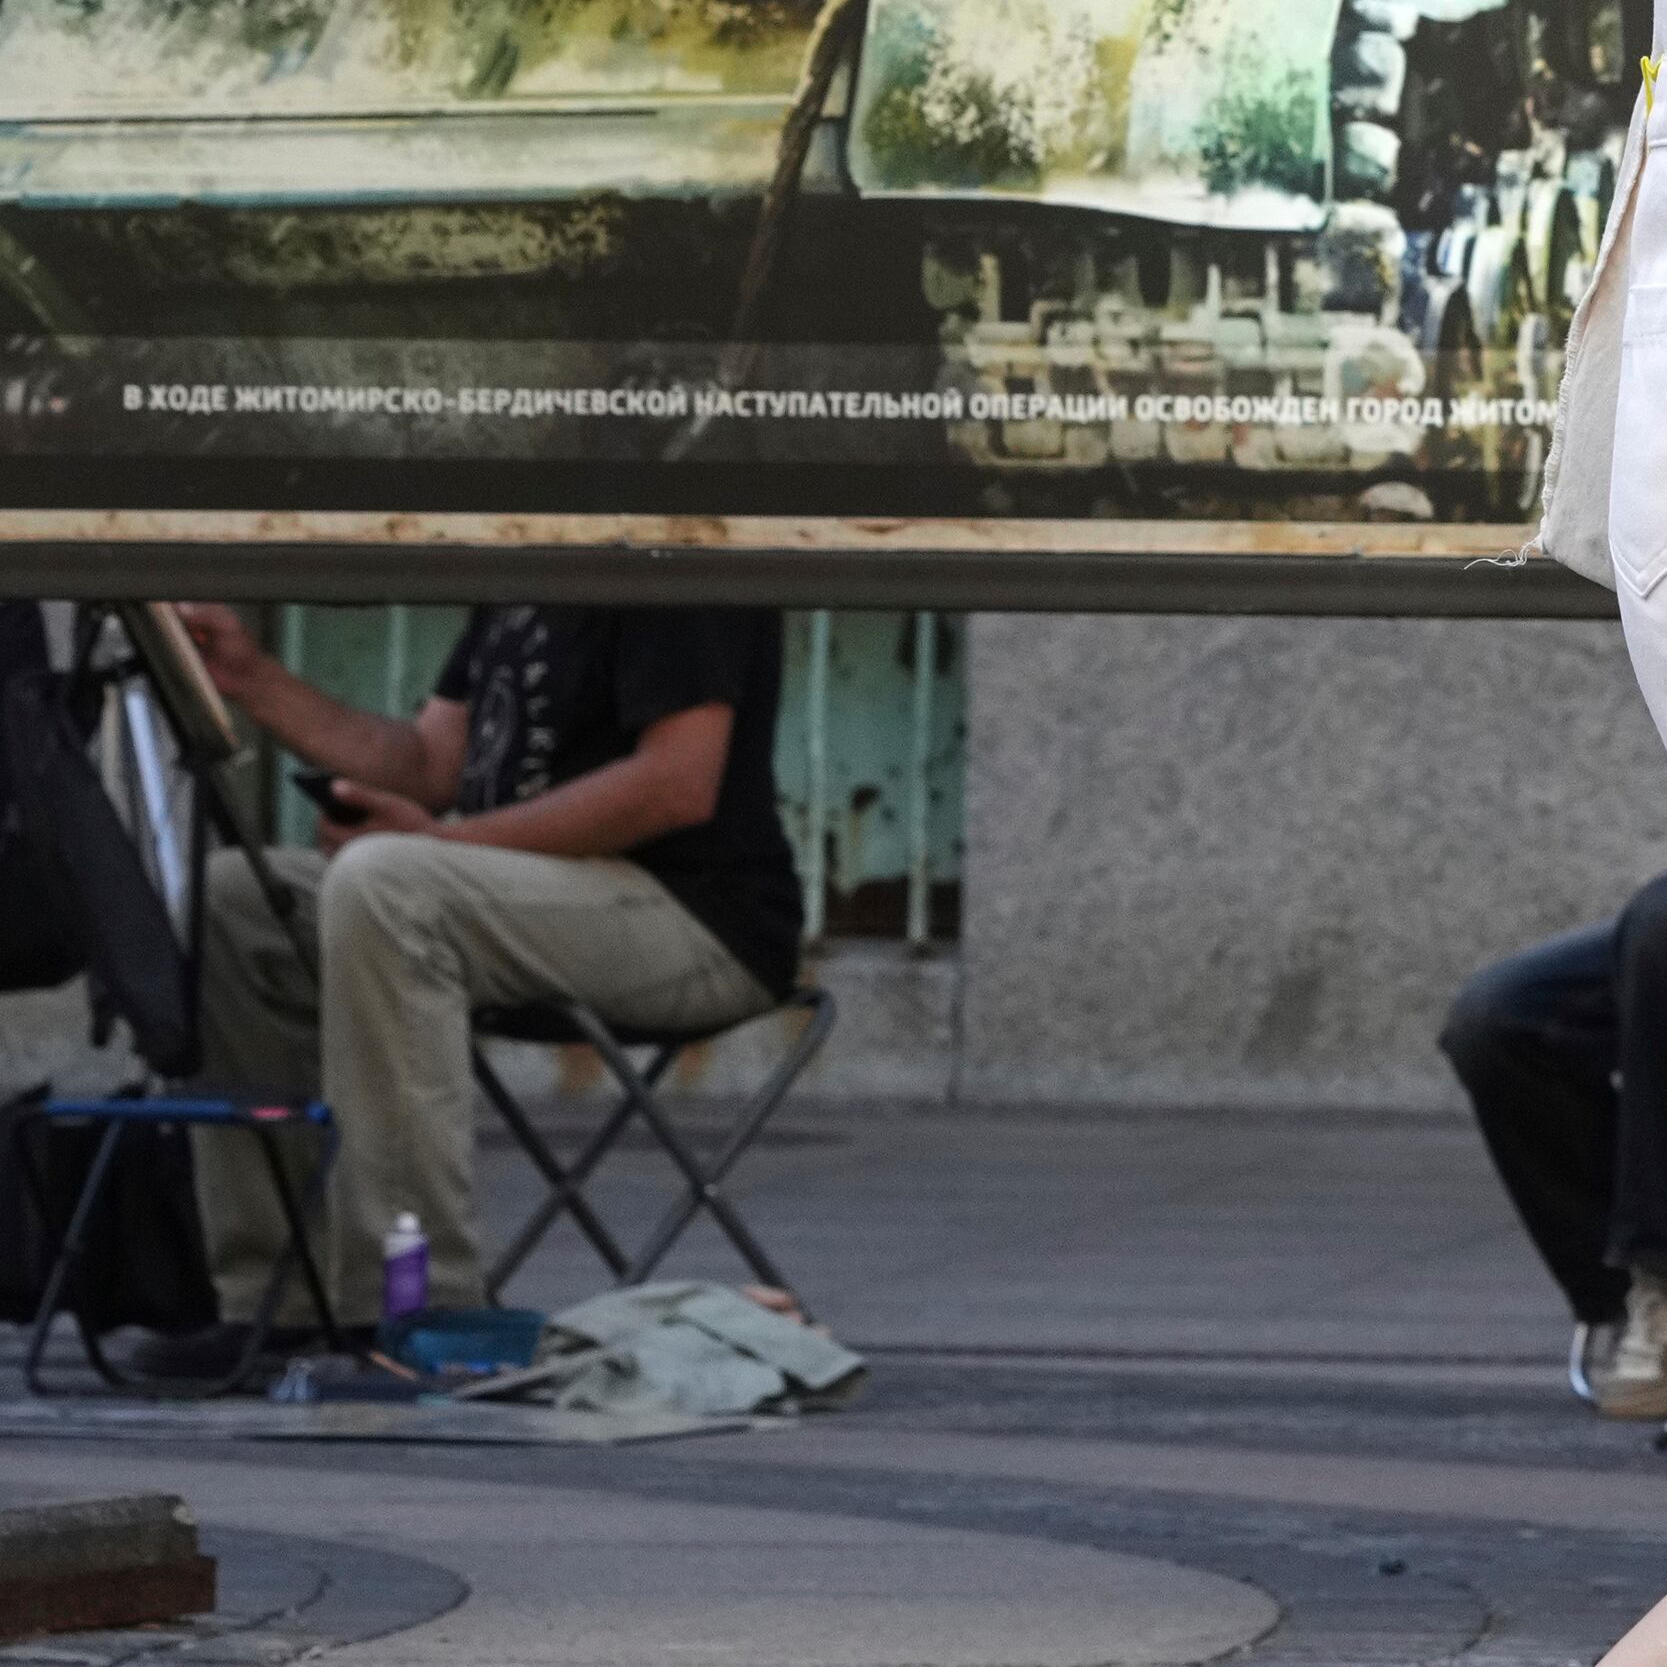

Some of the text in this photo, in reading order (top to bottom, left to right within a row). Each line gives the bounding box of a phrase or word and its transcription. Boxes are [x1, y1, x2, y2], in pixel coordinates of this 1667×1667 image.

[124, 385, 140, 411] В
[149, 385, 228, 414] ХОДЕ
[234, 383, 688, 417] ЖИТОМИРСКО-БЕРДИЧЕВСКОЙ
[695, 387, 963, 419] НАСТУПАТЕЛЬНОЙ
[970, 393, 1127, 424] ОПЕРАЦИИ
[1136, 395, 1339, 426] ОСВОБОЖДЕН
[1347, 398, 1443, 428] ГОРОД
